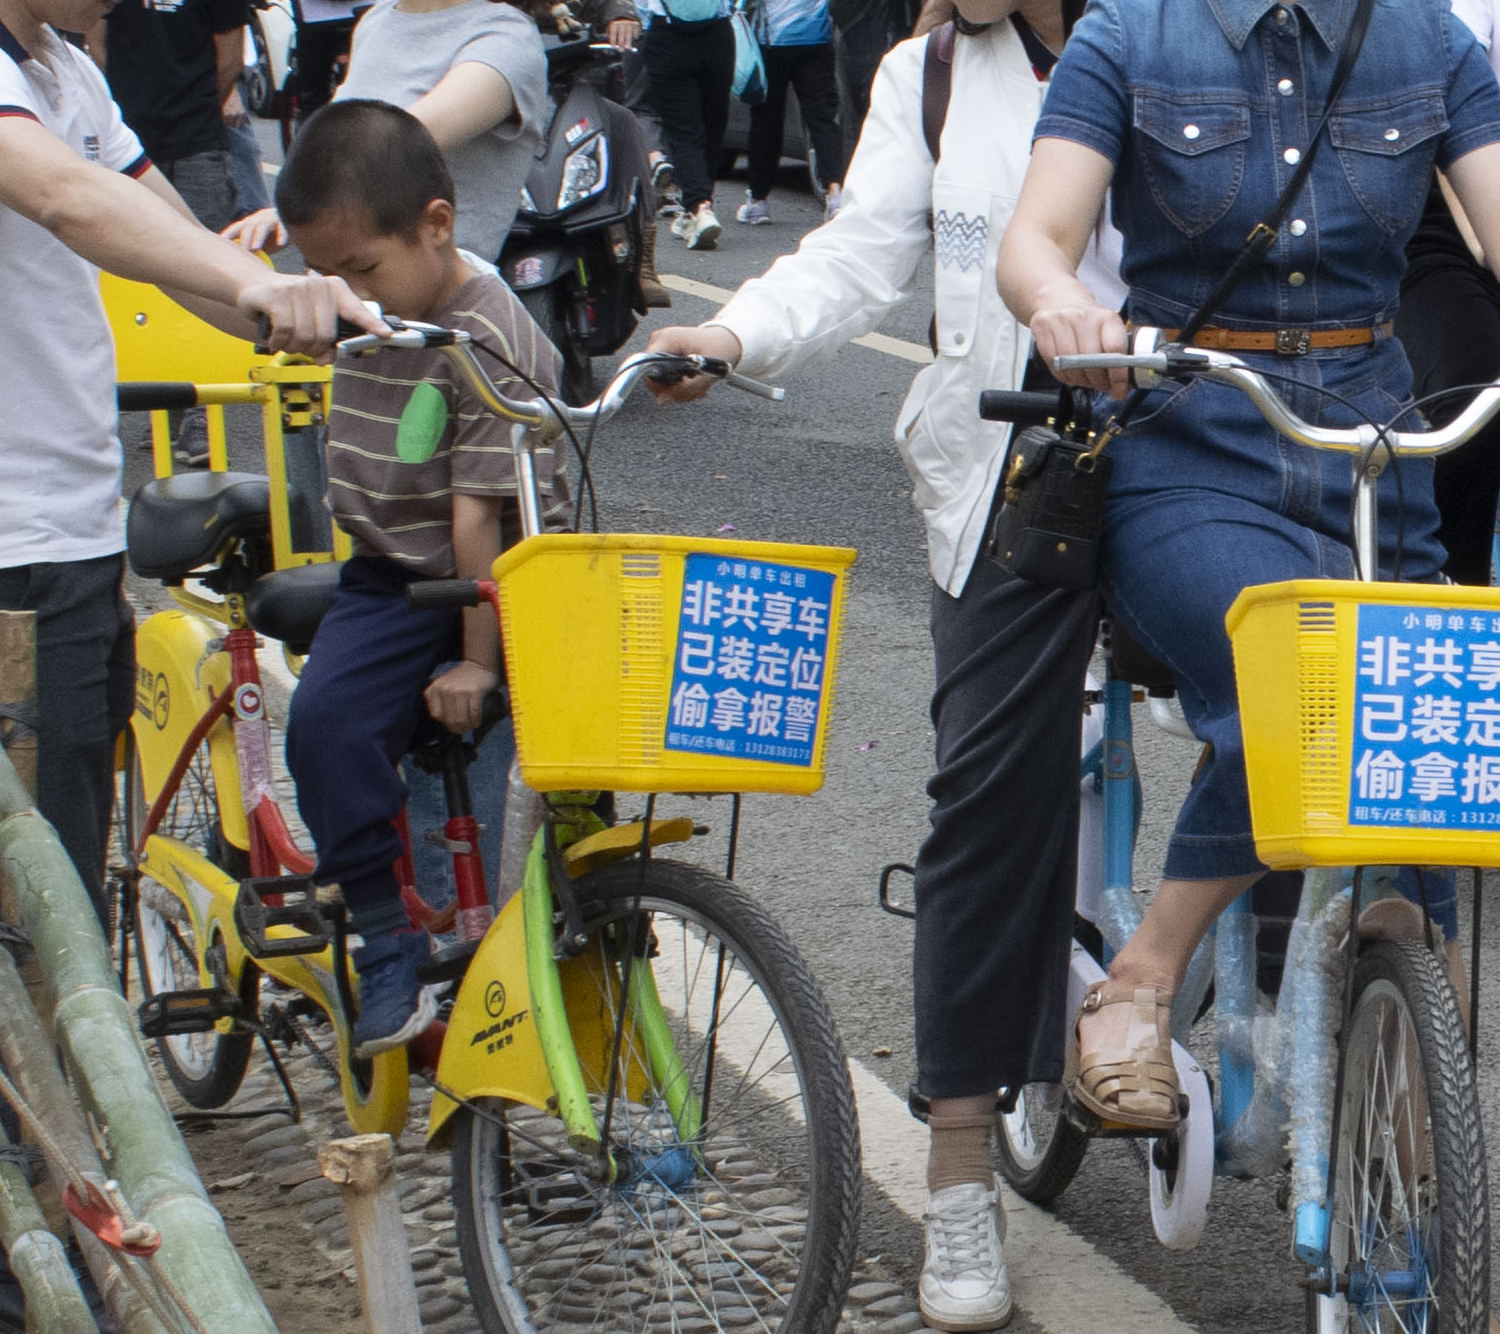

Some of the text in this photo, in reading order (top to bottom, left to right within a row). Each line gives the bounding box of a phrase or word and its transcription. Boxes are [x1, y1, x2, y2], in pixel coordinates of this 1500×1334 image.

[683, 580, 828, 641] 非共享车
[679, 630, 822, 692] 已装定位
[672, 681, 817, 743] 偷拿报警
